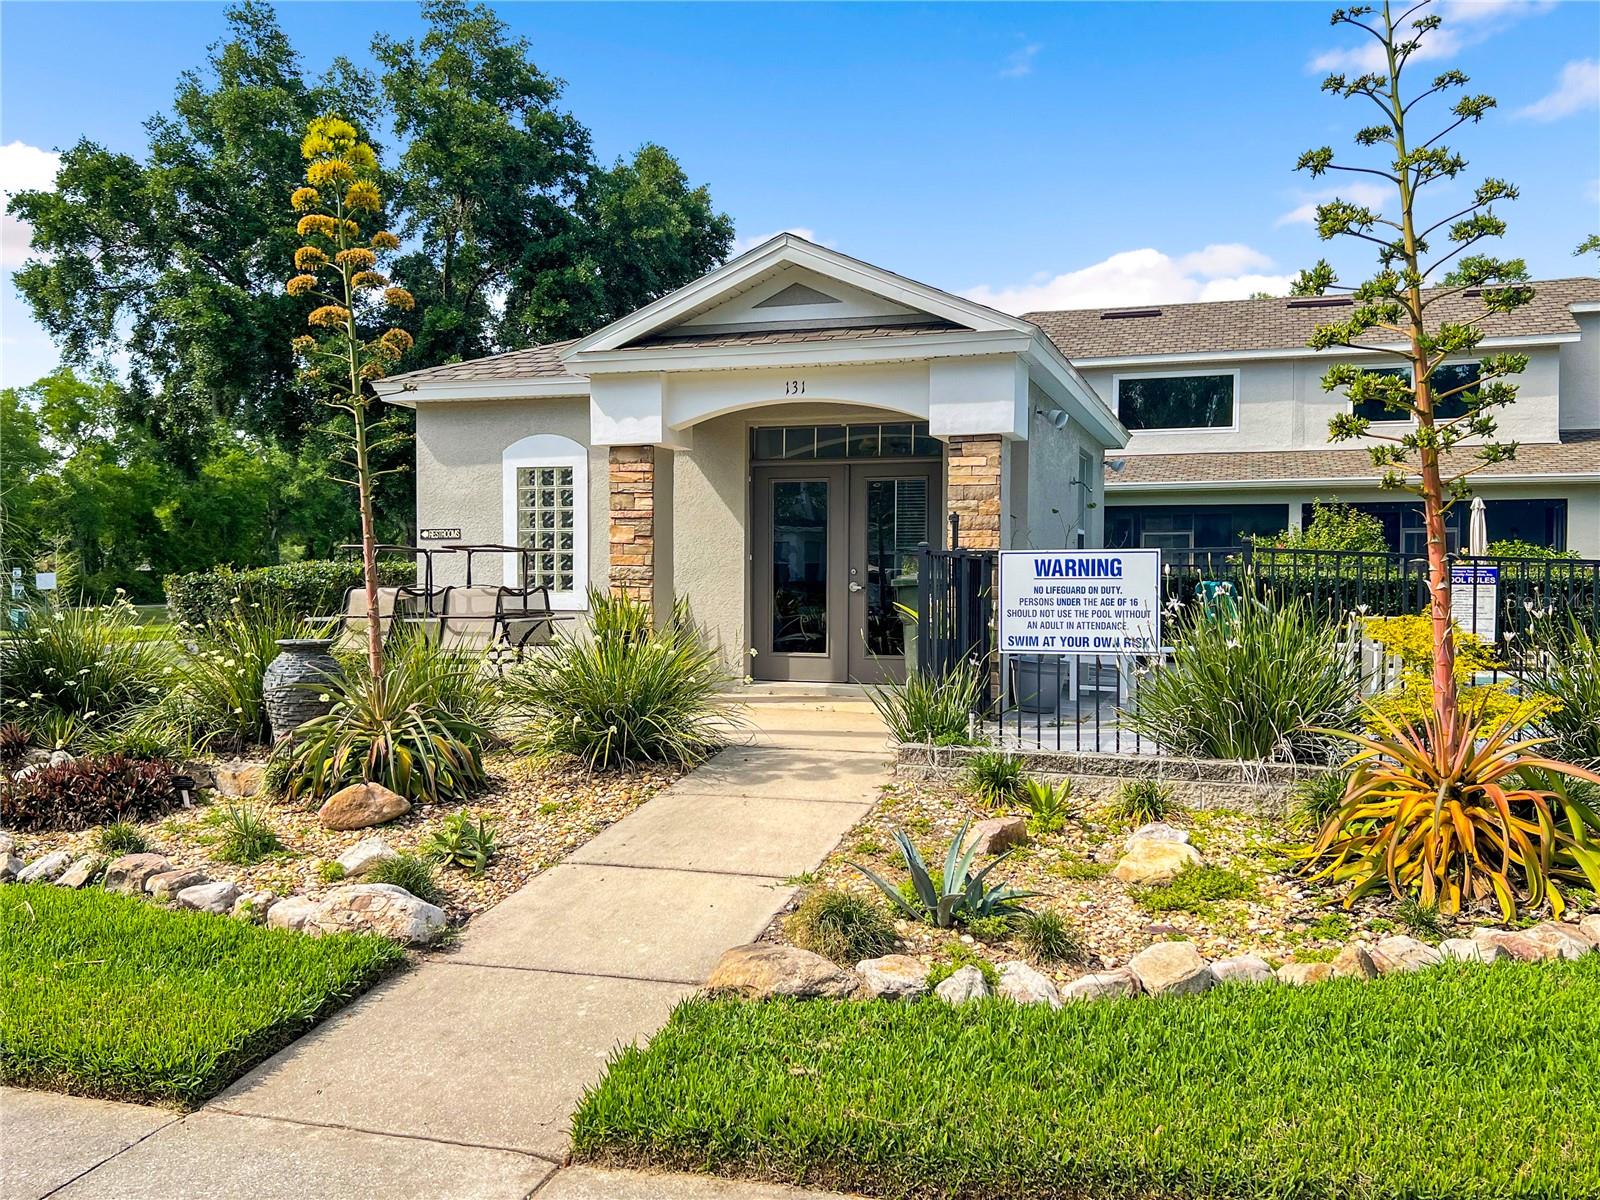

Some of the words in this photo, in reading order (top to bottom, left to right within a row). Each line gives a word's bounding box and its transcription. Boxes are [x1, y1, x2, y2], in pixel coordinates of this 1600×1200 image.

[786, 381, 805, 395] 131
[428, 530, 460, 538] RESTROOMS
[1034, 558, 1122, 577] WARNING
[1033, 586, 1044, 594] NO
[1046, 586, 1086, 594] LIFEGUARD
[1088, 586, 1099, 594] ON
[1100, 586, 1123, 594] DUTY.
[1019, 598, 1054, 606] PERSONS
[1056, 598, 1081, 606] UNDER
[1084, 598, 1098, 606] THE
[1100, 598, 1116, 606] AGE
[1117, 598, 1127, 606] OF
[1130, 598, 1138, 606] 16
[1006, 610, 1038, 618] SHOULD
[1040, 610, 1056, 618] NOT
[1057, 610, 1072, 618] USE
[1074, 610, 1089, 618] THE
[1091, 610, 1112, 618] POOL
[1114, 610, 1152, 618] WITHOUT
[1026, 621, 1038, 630] AN
[1040, 621, 1064, 630] ADULT
[1066, 621, 1075, 630] IN
[1008, 636, 1038, 647] SWIM
[1042, 636, 1056, 647] AT
[1060, 636, 1090, 648] YOUR
